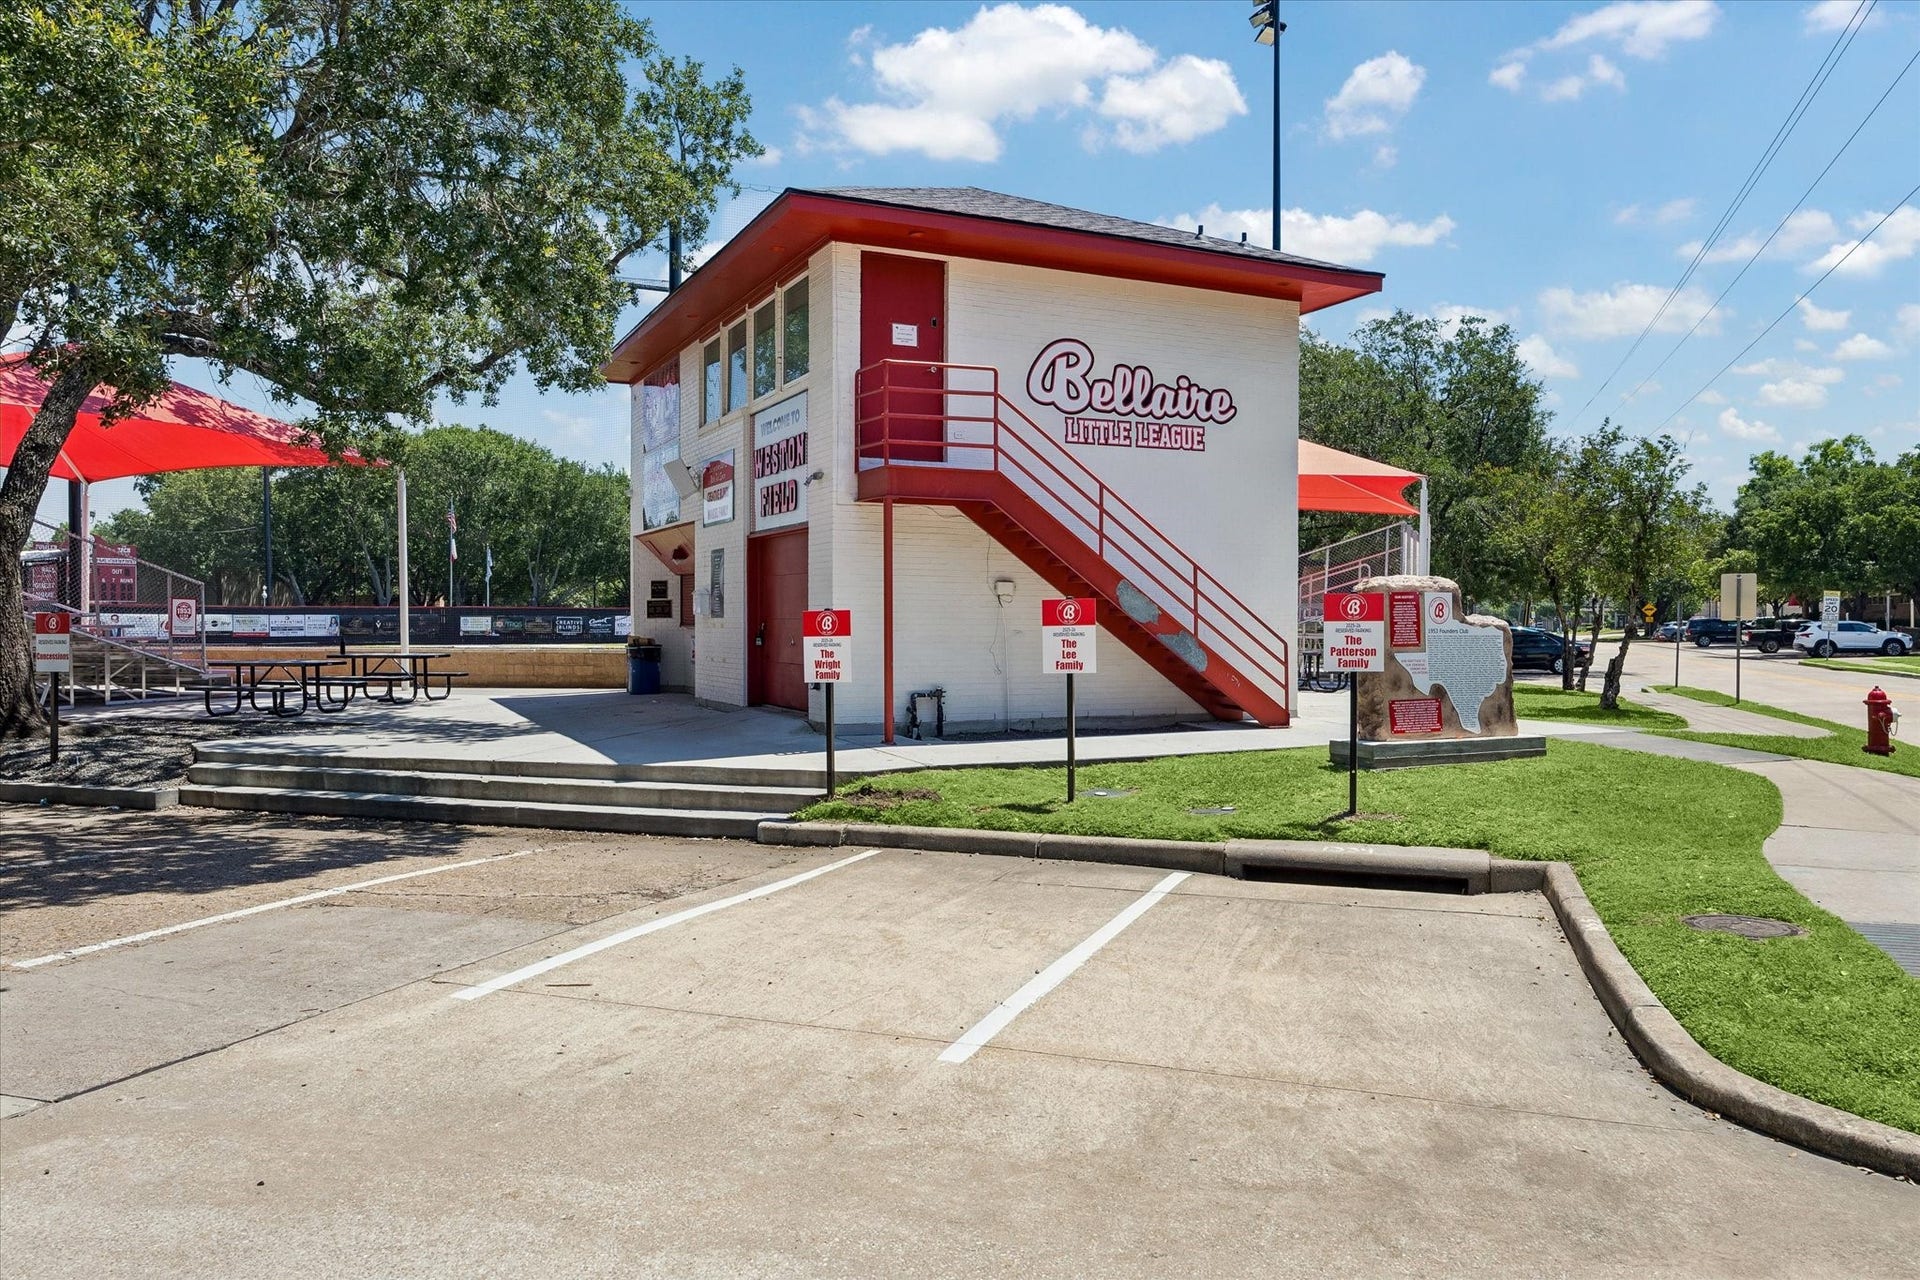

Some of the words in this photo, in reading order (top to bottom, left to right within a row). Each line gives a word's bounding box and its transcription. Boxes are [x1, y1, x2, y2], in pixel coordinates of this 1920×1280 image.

[1026, 338, 1237, 425] Bellaire
[760, 411, 790, 437] WELCOME
[791, 408, 801, 424] TO
[1065, 416, 1132, 448] LITTLE
[1135, 421, 1206, 451] LEAGUE
[755, 431, 808, 479] WESTON
[761, 479, 798, 517] FIELD
[1824, 605, 1838, 613] 20
[1061, 639, 1077, 648] The
[1344, 635, 1362, 645] The
[36, 652, 69, 660] Concessions
[820, 649, 834, 658] The
[1062, 650, 1076, 659] Lee
[1330, 646, 1377, 657] Patterson
[815, 660, 841, 670] Wright
[1055, 661, 1083, 671] Family
[1338, 658, 1369, 669] Family
[815, 671, 841, 680] Family
